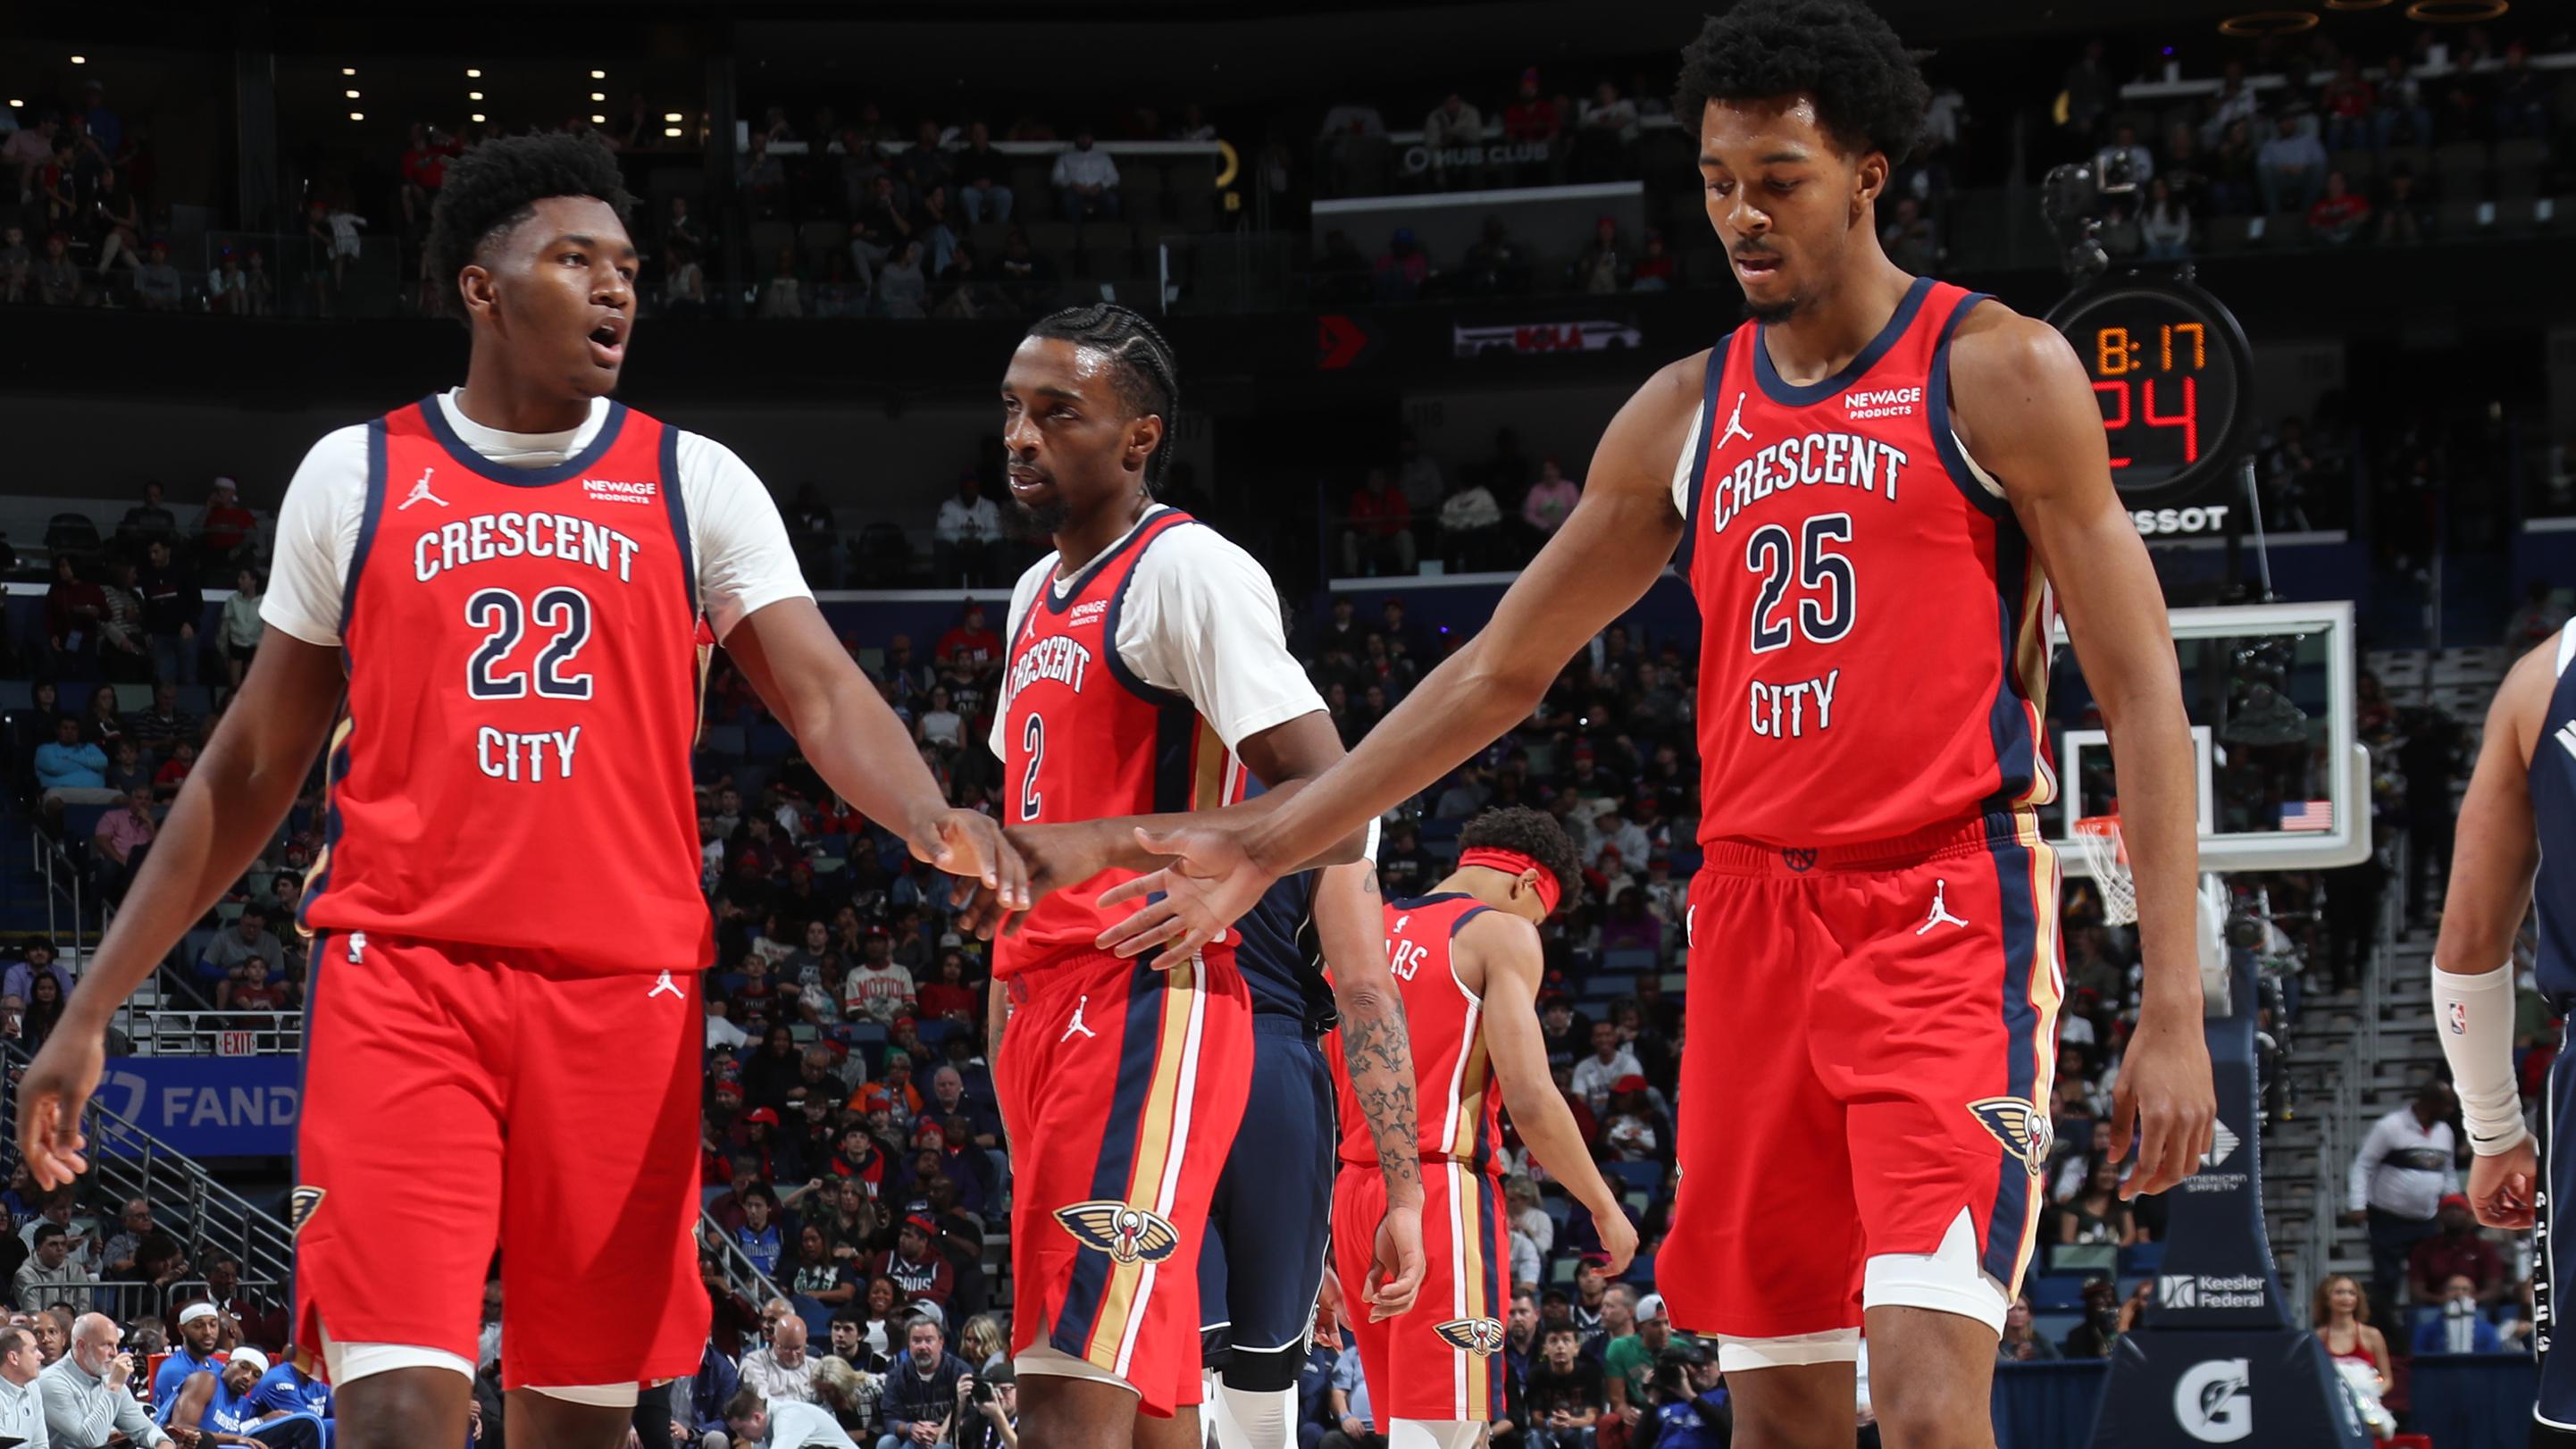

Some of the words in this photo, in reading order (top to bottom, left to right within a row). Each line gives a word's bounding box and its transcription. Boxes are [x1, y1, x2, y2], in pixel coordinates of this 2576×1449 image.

[1487, 140, 1551, 163] CLUB
[2096, 322, 2207, 376] 8:17
[1844, 387, 1921, 409] NEWAGE
[1850, 405, 1912, 420] PRODUCTS
[582, 479, 657, 496] NEWAGE
[1713, 431, 1908, 534] CRESCENT
[590, 492, 650, 506] PRODUCTS
[414, 511, 640, 583] CRESCENT
[1745, 511, 1857, 655] 25
[1071, 600, 1108, 619] NEWAGE
[464, 585, 593, 701] 22
[1006, 635, 1091, 714] CRESCENT
[1750, 668, 1840, 739] CITY
[476, 724, 582, 783] CITY
[1021, 712, 1045, 822] 2
[224, 1032, 253, 1055] EXIT
[2184, 1173, 2248, 1184] MERICAN
[2187, 1183, 2239, 1194] SAFETY
[2199, 1273, 2266, 1292] Keesler
[2200, 1292, 2265, 1309] Federal
[2173, 1357, 2254, 1445] G
